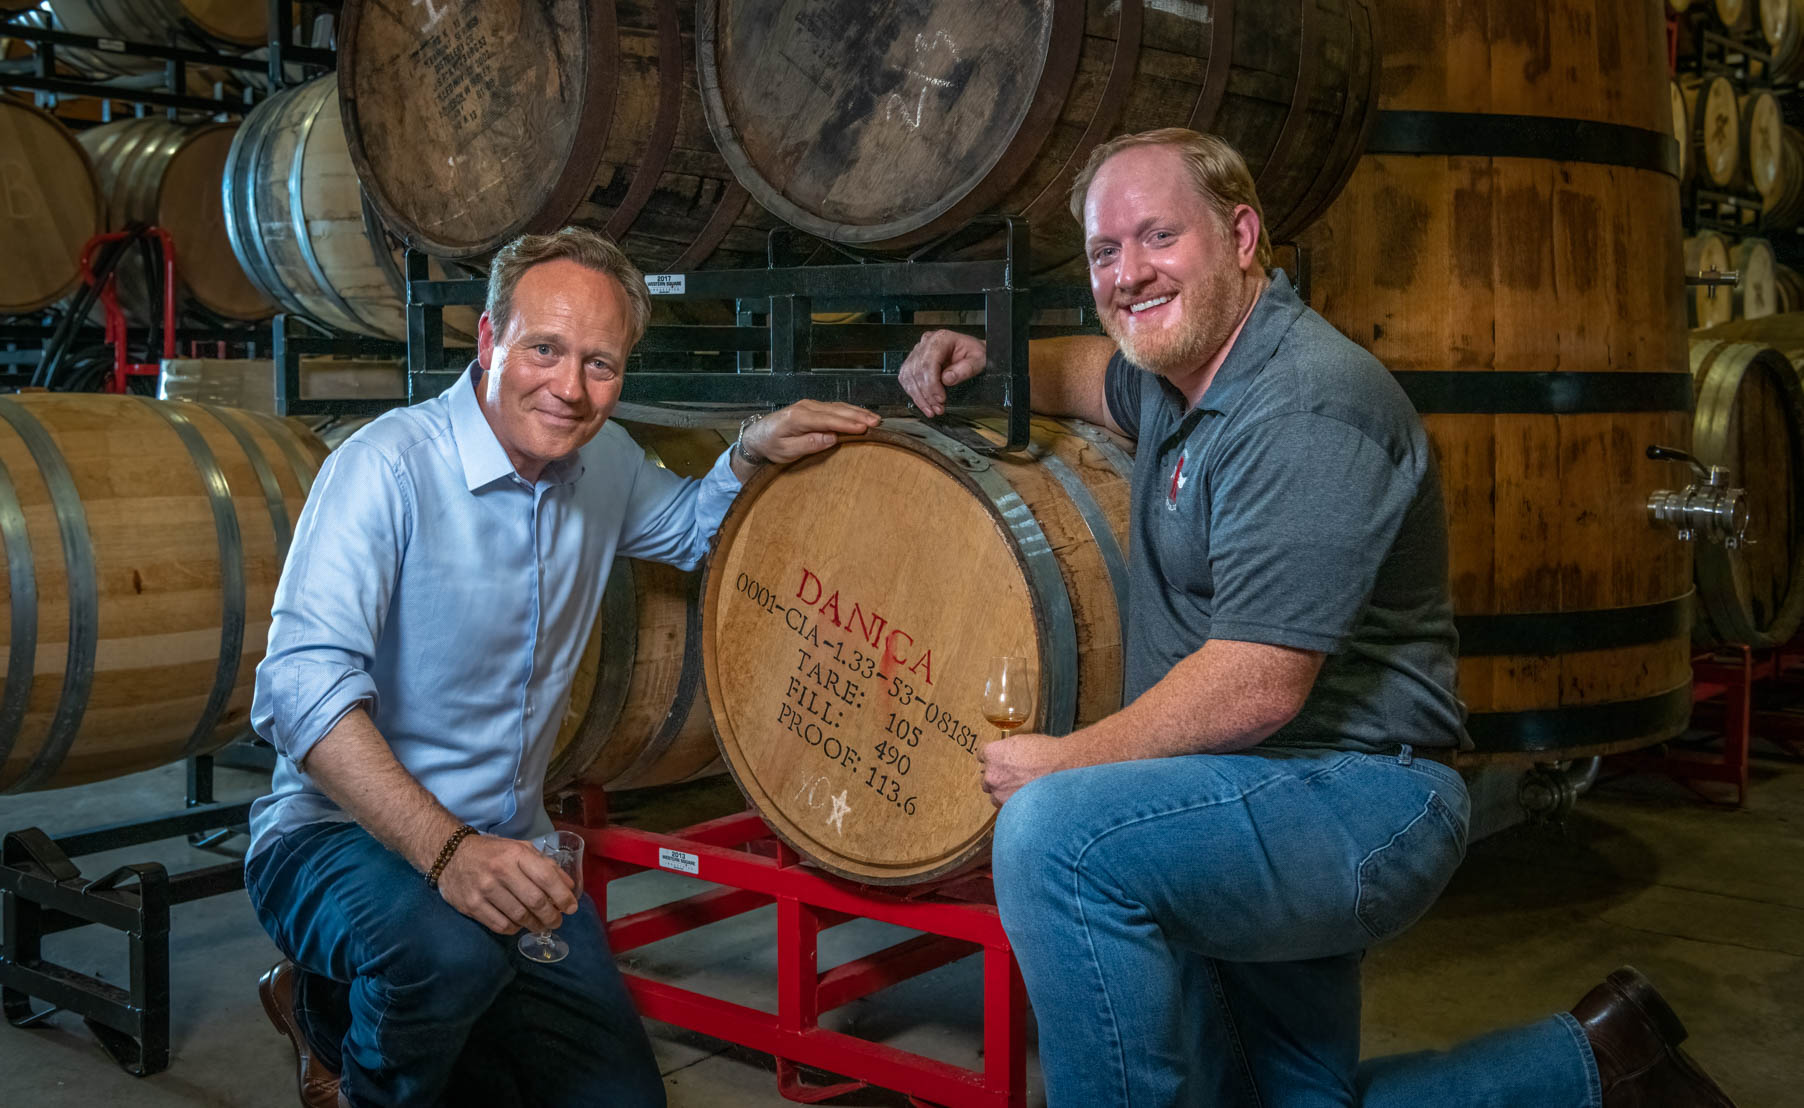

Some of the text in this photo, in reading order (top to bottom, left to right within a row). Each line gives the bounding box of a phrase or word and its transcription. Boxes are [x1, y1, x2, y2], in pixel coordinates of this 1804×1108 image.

[796, 568, 933, 685] DANICA
[786, 676, 911, 776] FILL: 490
[798, 649, 922, 747] TARE: 105
[777, 703, 917, 816] PROOF: 113.6
